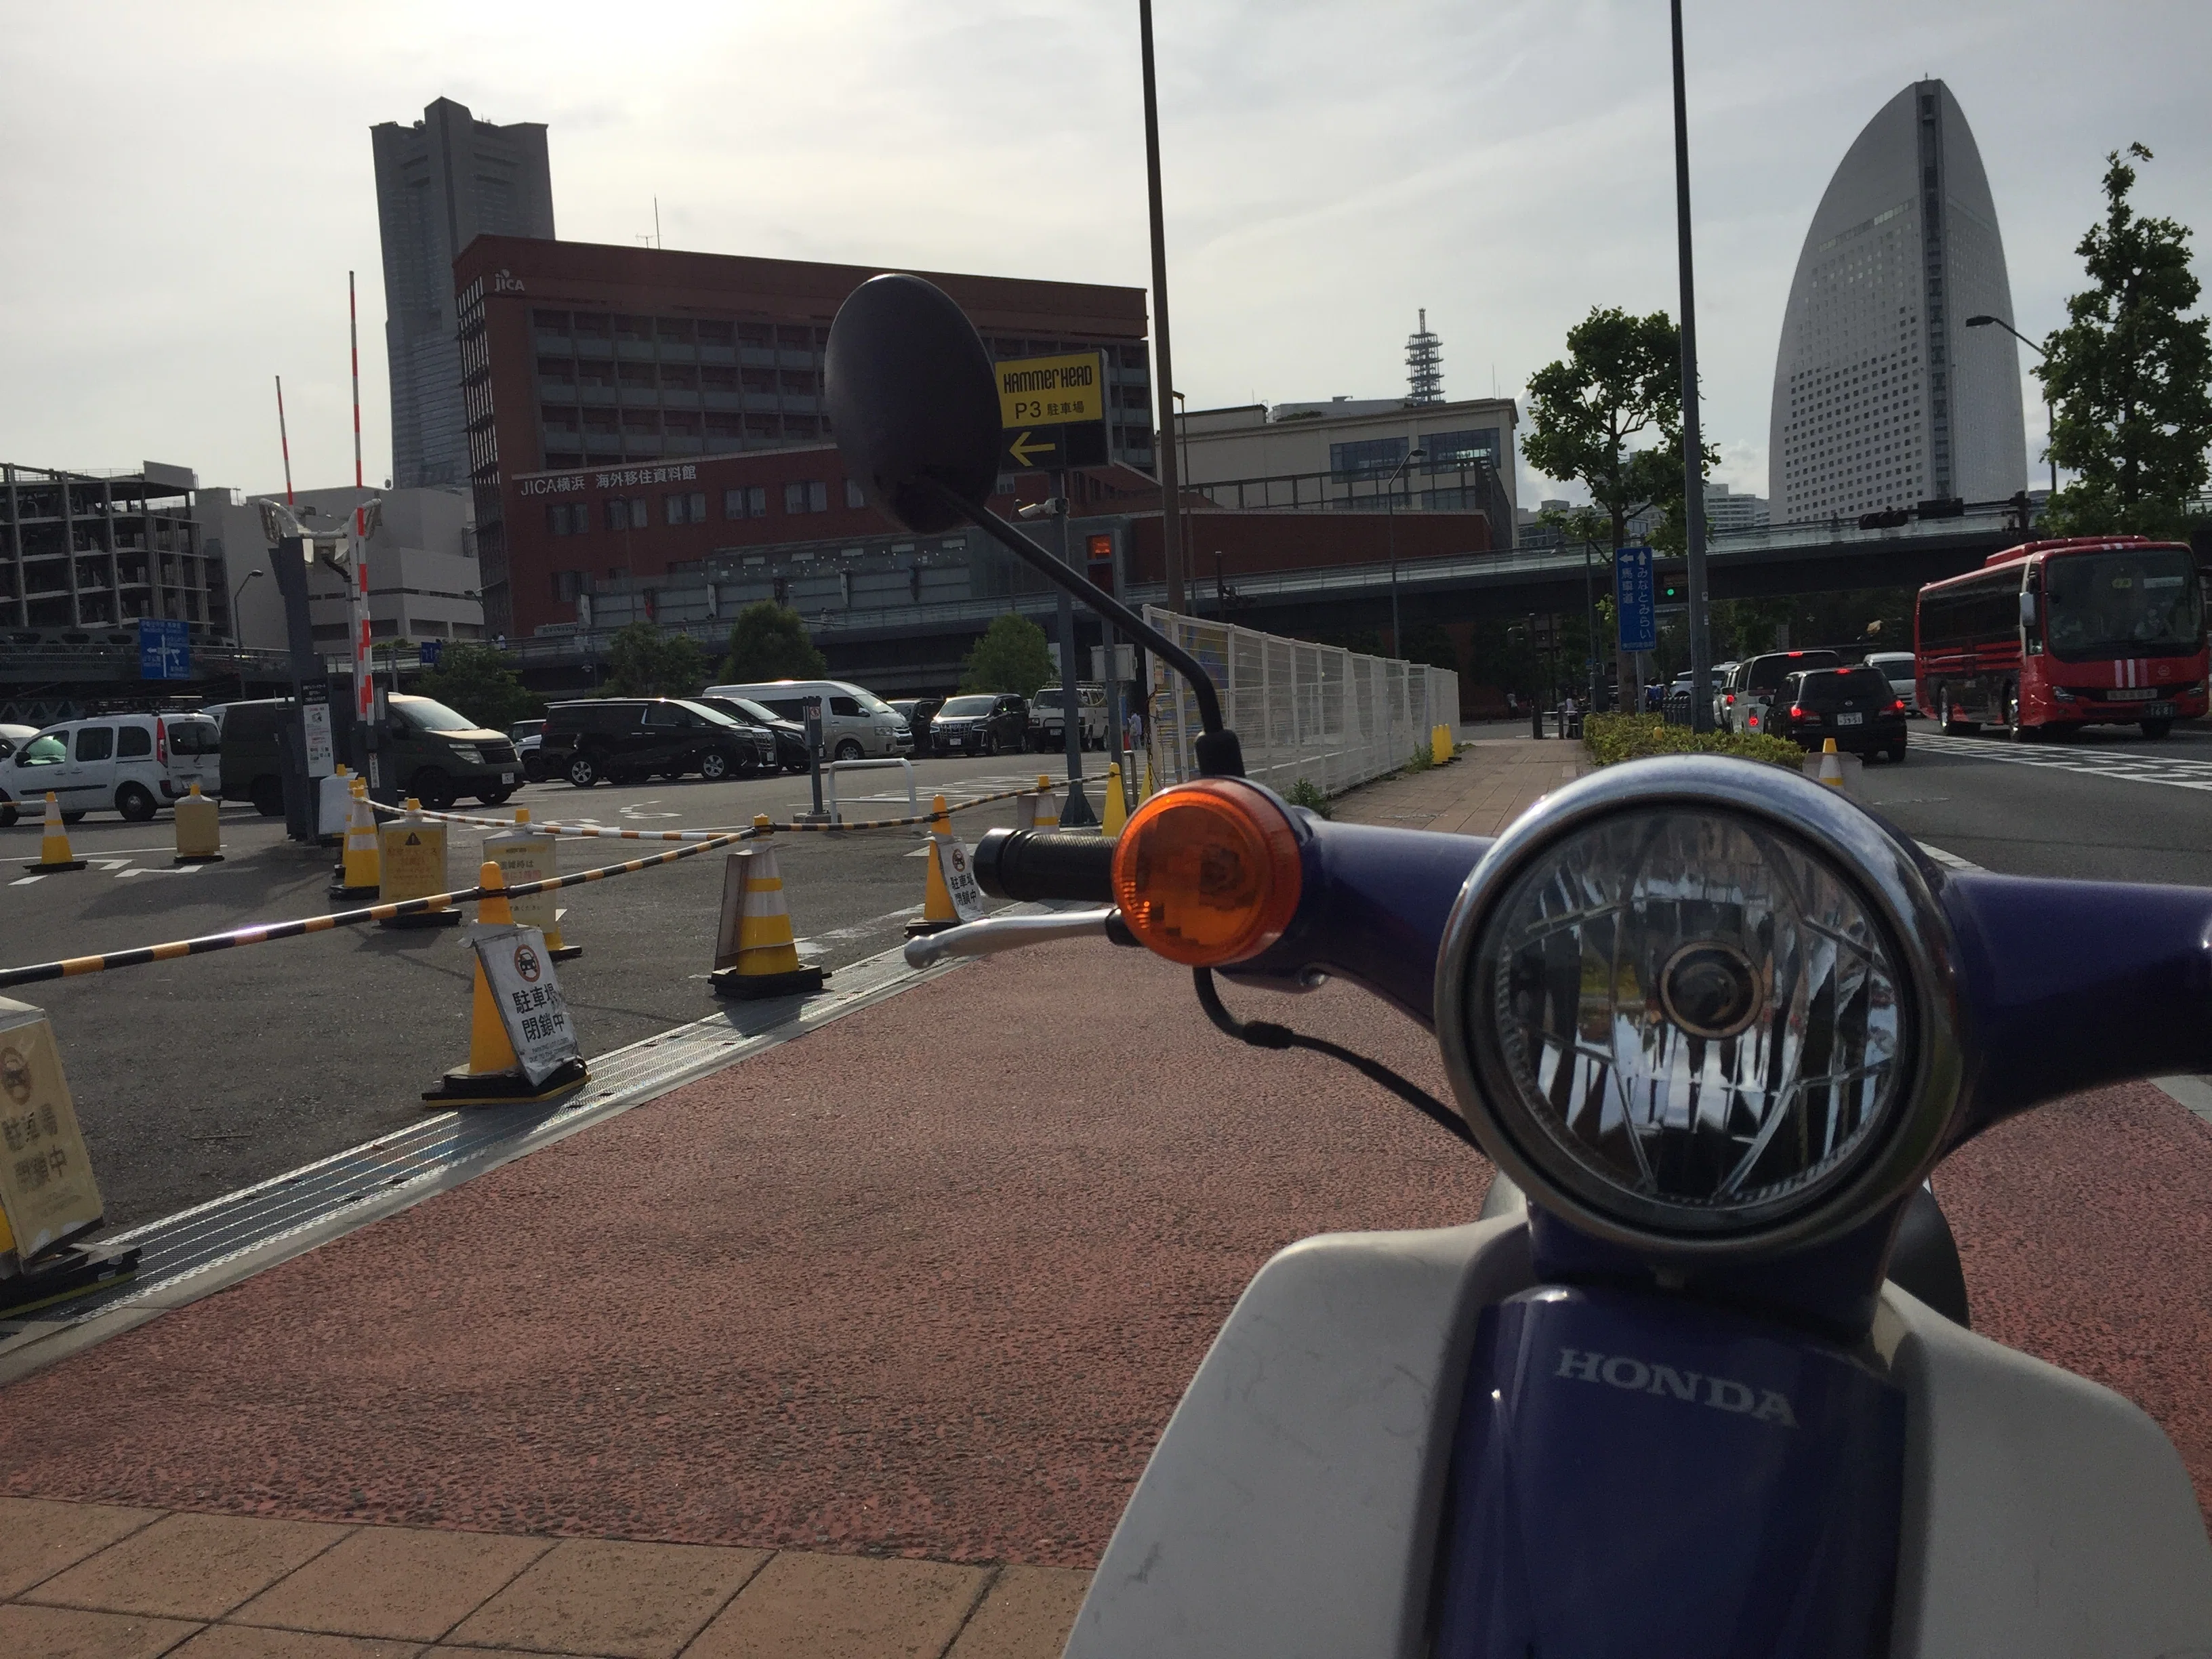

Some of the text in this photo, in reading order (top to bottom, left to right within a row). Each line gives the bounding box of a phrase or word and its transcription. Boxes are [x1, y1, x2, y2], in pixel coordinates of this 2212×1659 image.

[1015, 401, 1084, 419] P3 駐車場
[520, 466, 697, 496] JICA横浜 海外移住資料館
[1637, 567, 1651, 639] みなとみらい
[950, 873, 975, 890] 駐車場
[522, 1012, 565, 1043] 閉鎖中
[1555, 1347, 1801, 1429] HONDA
